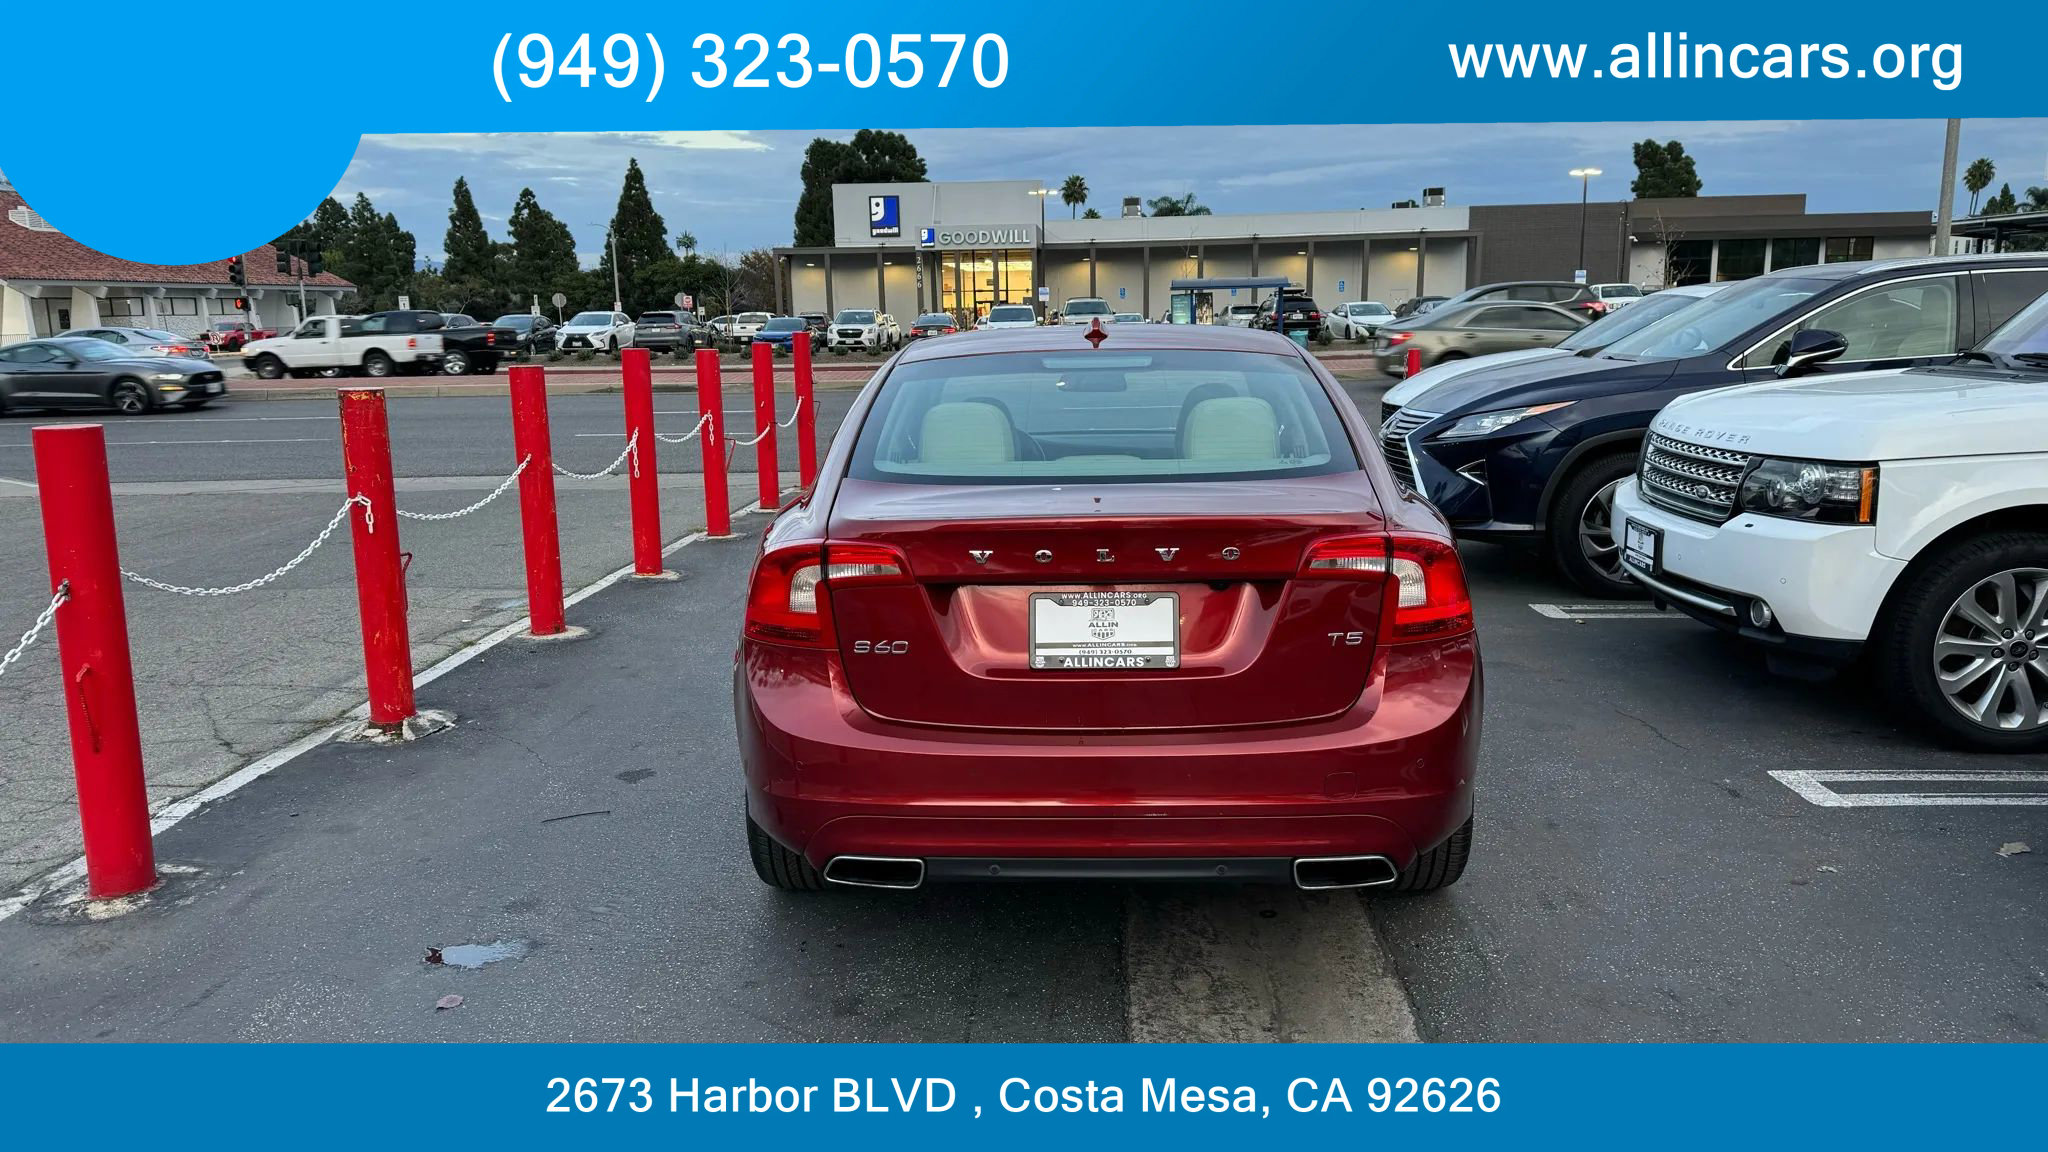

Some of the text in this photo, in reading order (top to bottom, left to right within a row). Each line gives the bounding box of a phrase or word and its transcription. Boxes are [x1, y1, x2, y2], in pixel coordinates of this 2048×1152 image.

[872, 226, 899, 236] goodwill
[938, 229, 1031, 245] GOODWILL
[1694, 428, 1751, 445] ROVER
[969, 546, 1241, 564] VOLVO
[1071, 599, 1137, 607] 949-323-0570
[853, 639, 909, 654] S60
[1327, 631, 1364, 647] T5
[1063, 656, 1146, 668] ALLINCARS
